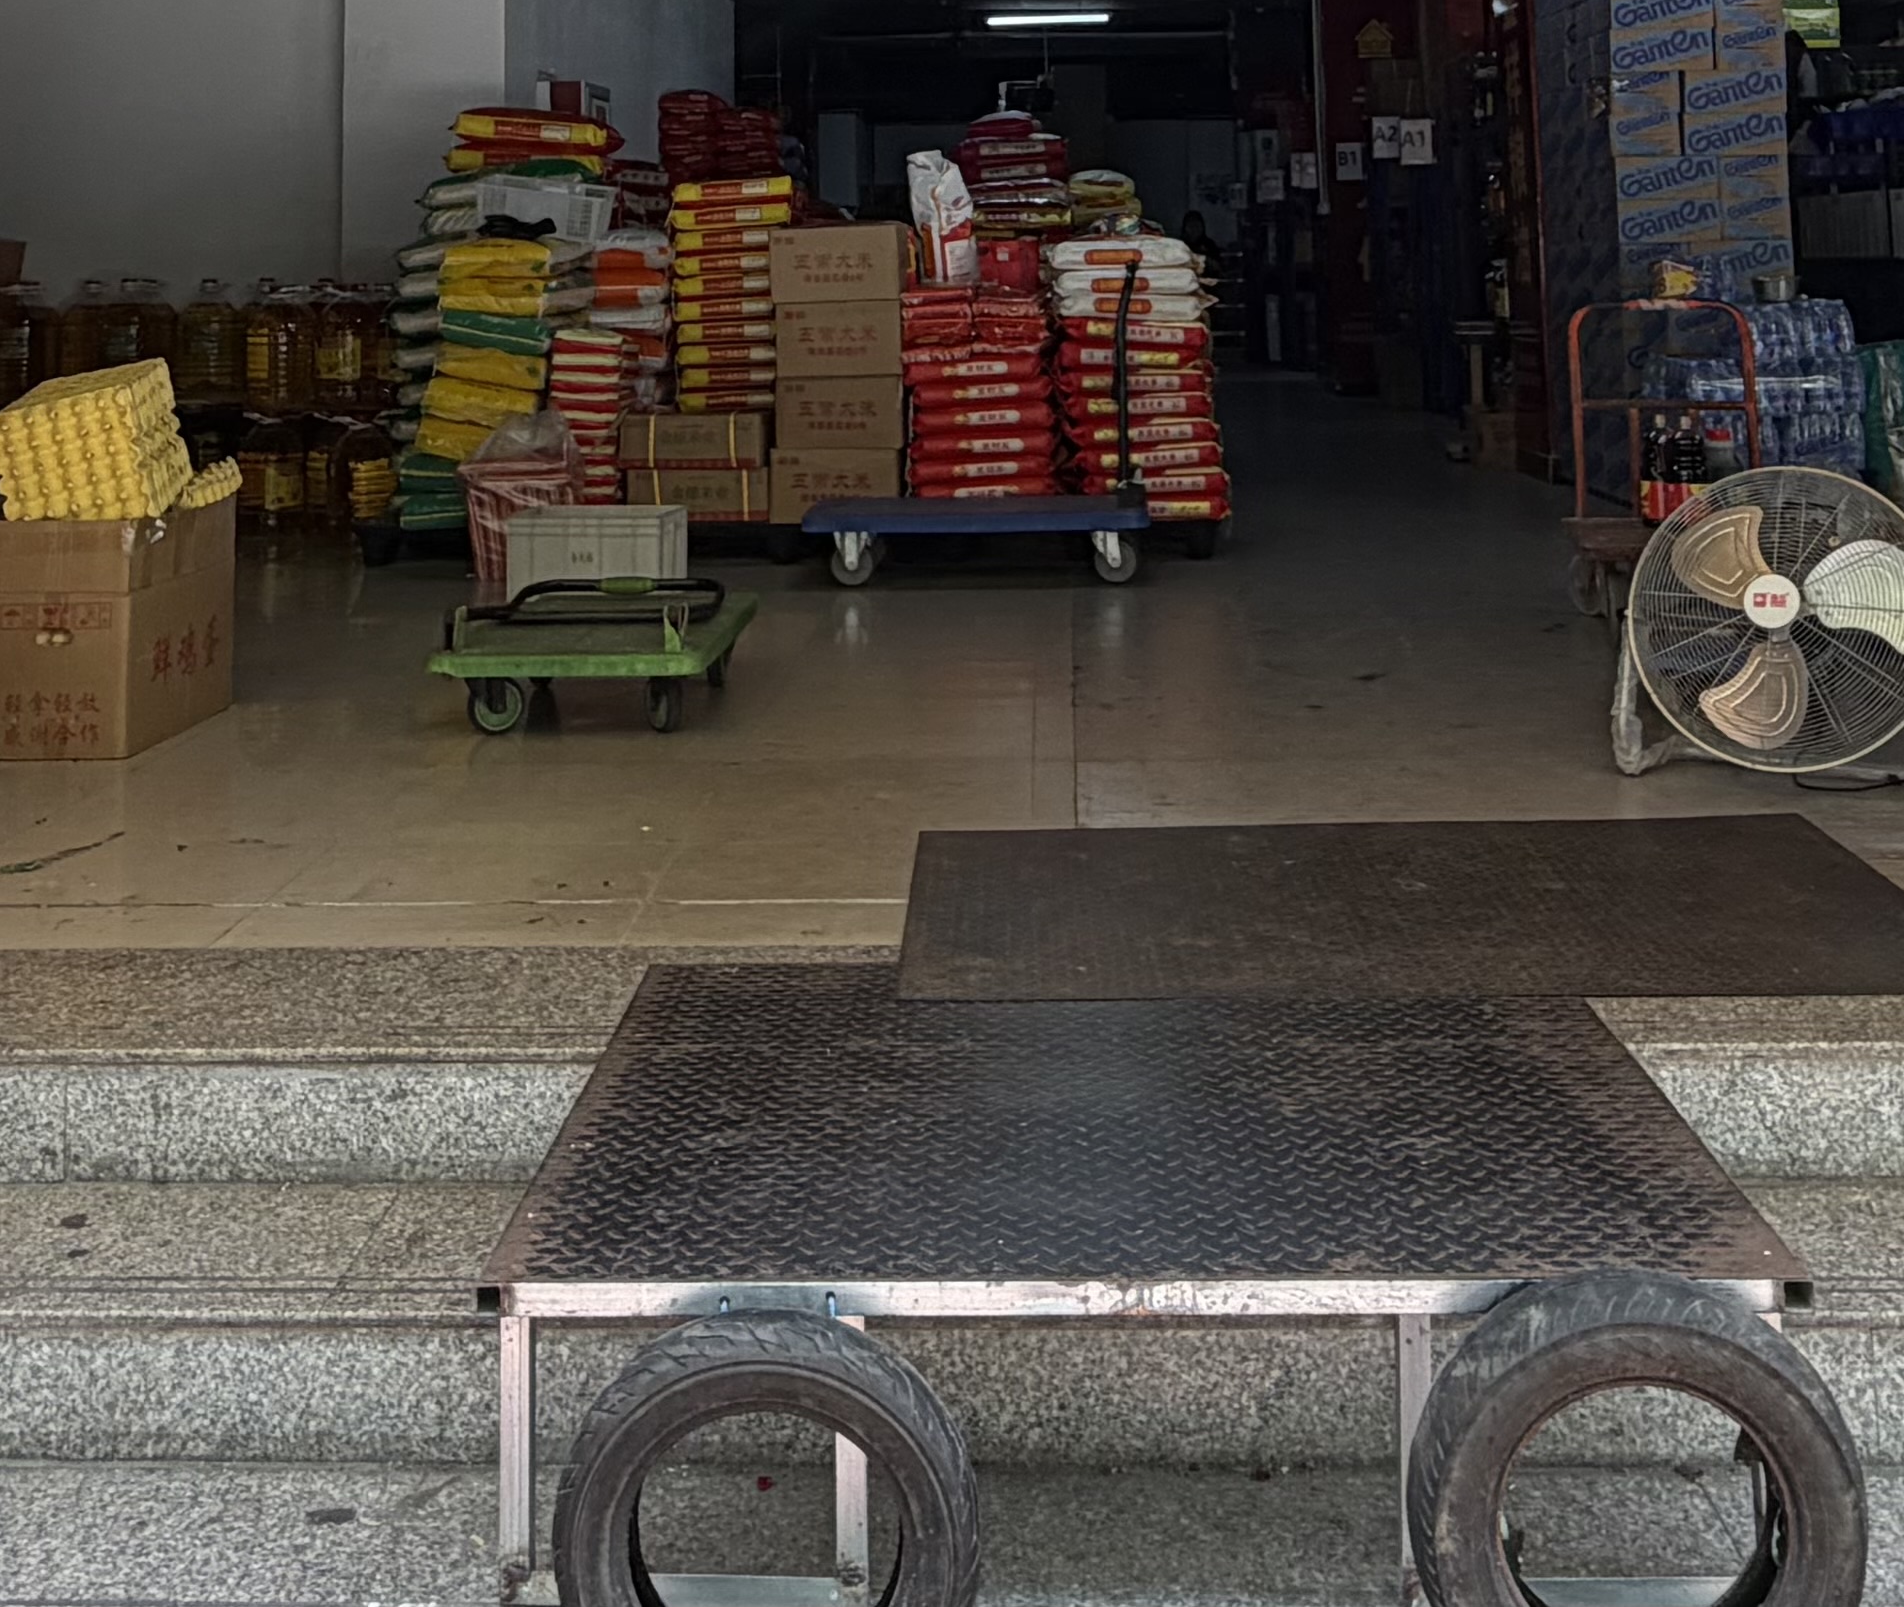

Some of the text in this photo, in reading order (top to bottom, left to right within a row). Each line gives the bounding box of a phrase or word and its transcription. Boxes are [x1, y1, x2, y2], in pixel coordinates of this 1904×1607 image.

[1612, 30, 1709, 69] Ganten
[1687, 72, 1783, 110] Ganten
[1375, 126, 1397, 142] A2
[1403, 130, 1425, 146] A1
[1688, 113, 1784, 153] Ganten
[1338, 151, 1356, 166] B1
[1619, 157, 1716, 197] Ganten
[1621, 200, 1718, 240] Ganten
